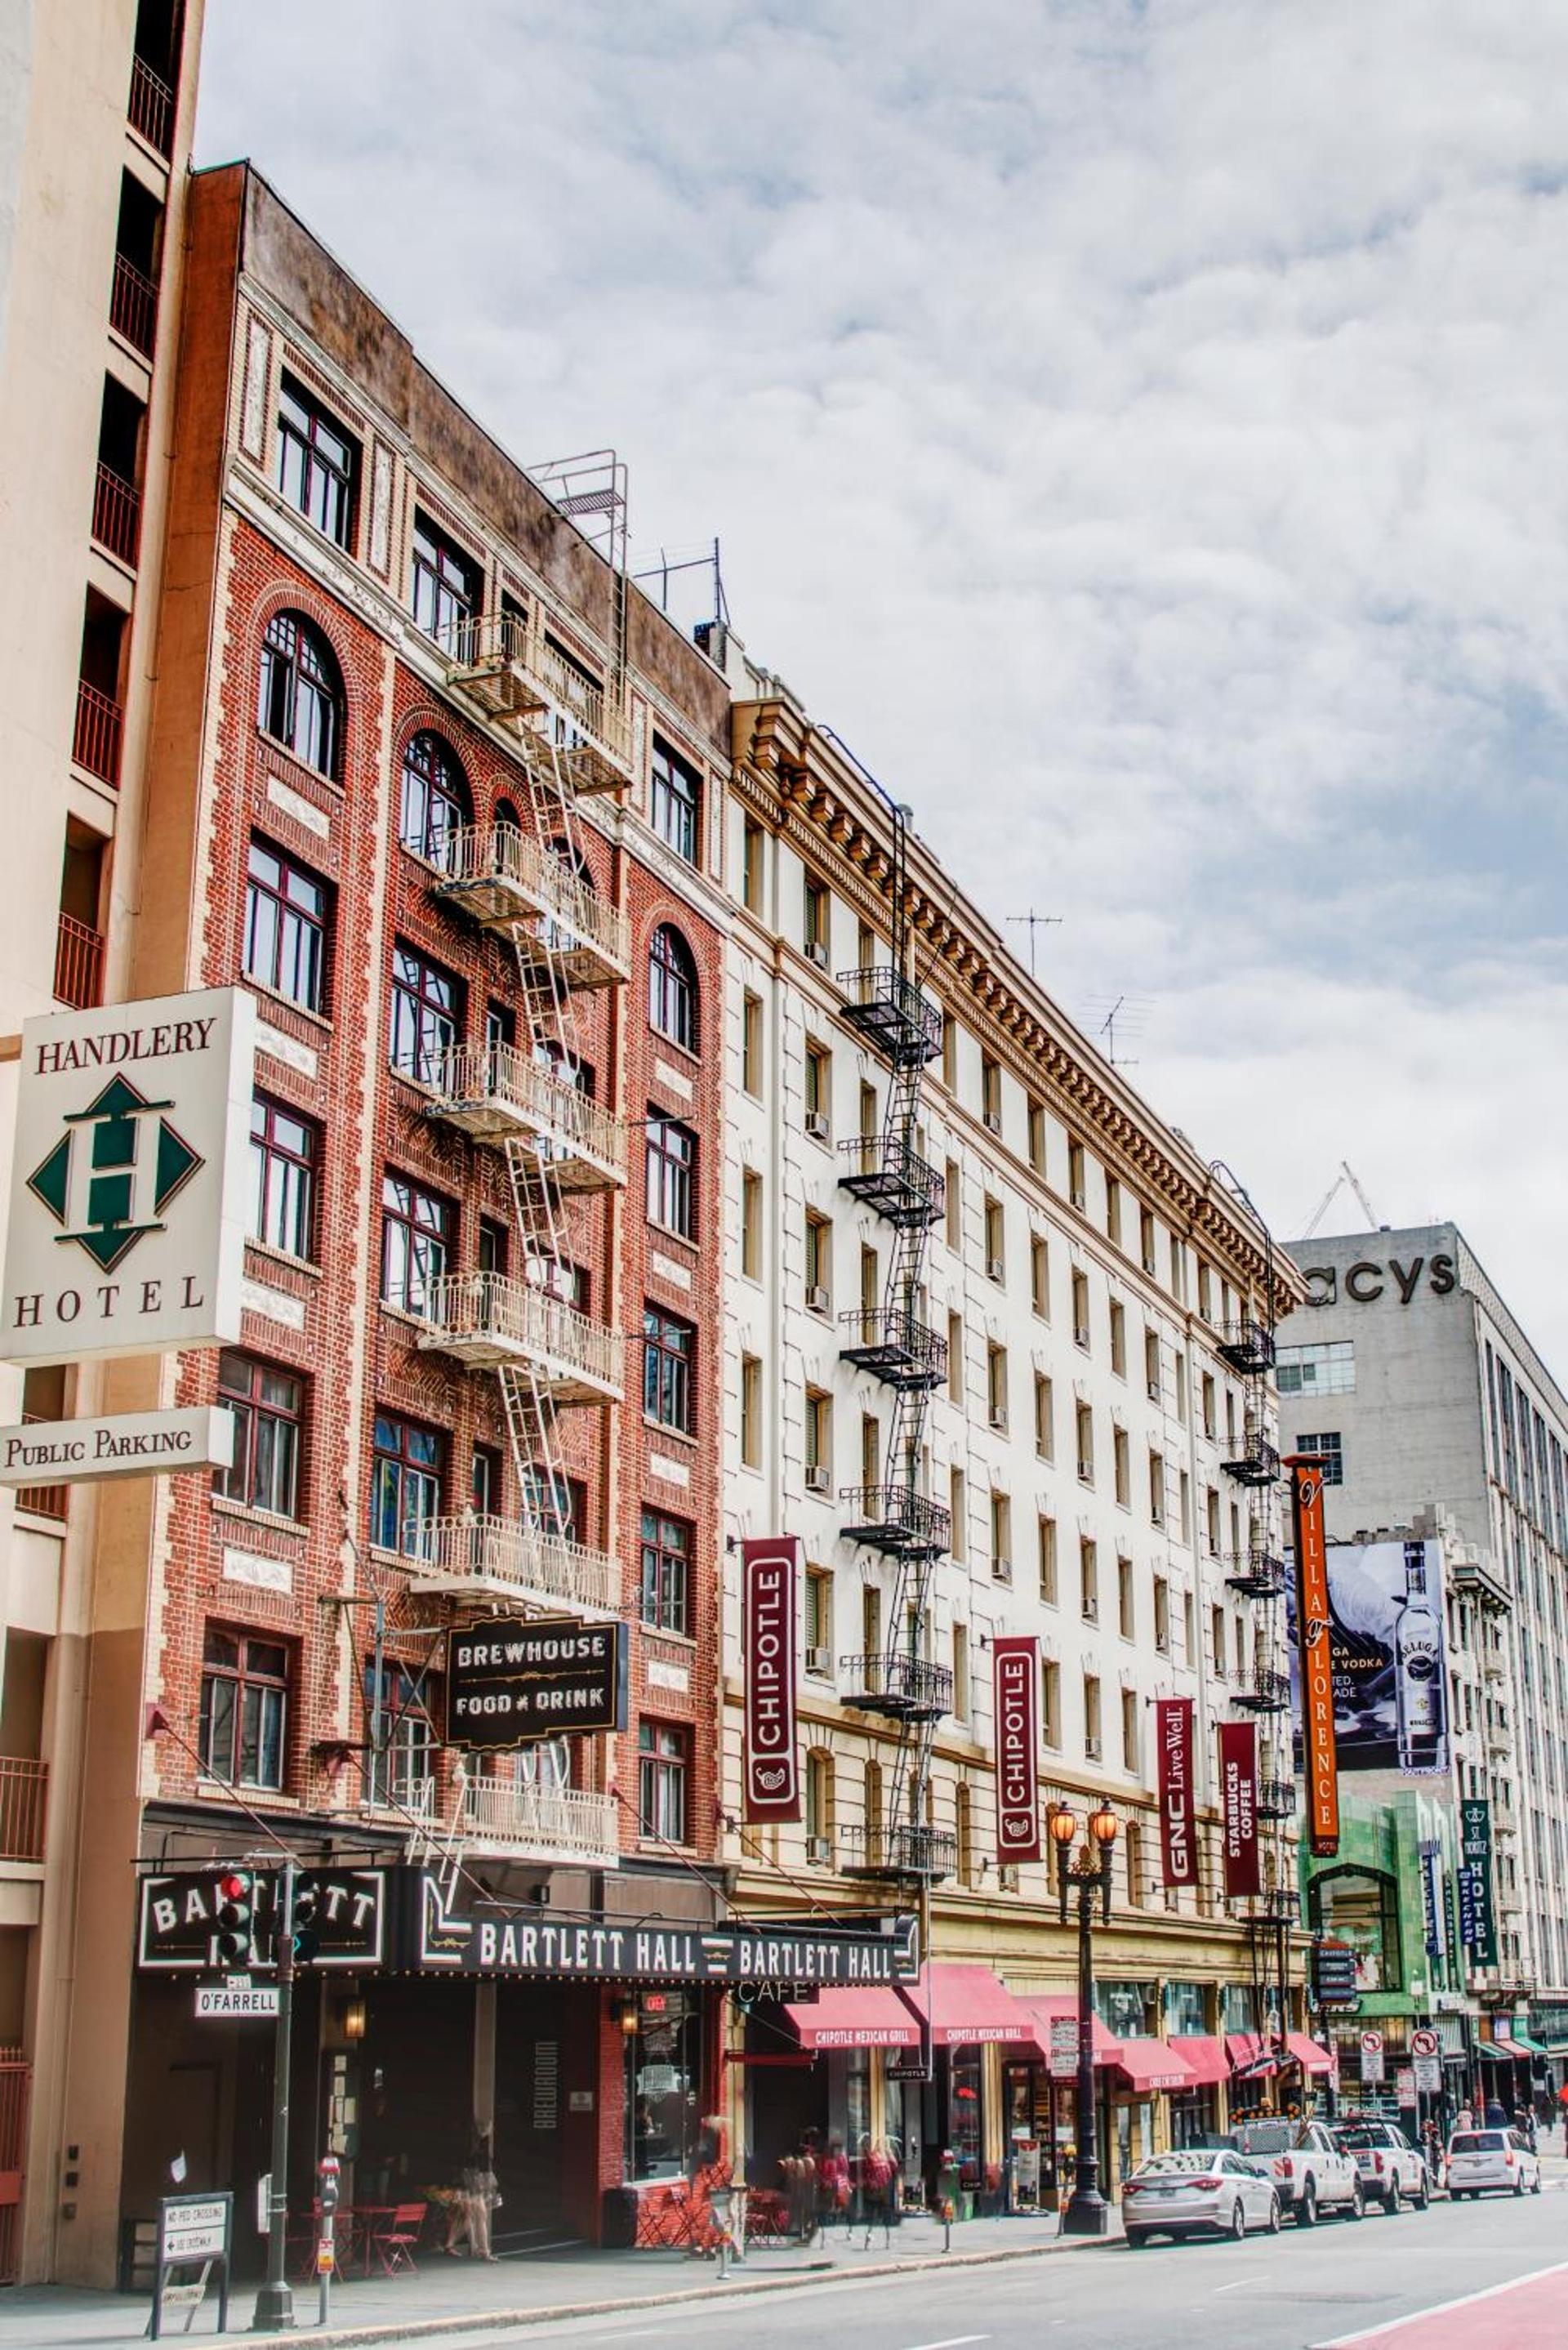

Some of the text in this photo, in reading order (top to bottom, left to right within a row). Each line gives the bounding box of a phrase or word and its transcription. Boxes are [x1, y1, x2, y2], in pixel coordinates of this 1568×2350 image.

[34, 1018, 216, 1075] HANDLERY
[13, 1275, 204, 1328] HOTEL
[1302, 1254, 1455, 1307] acys
[1299, 1477, 1329, 1612] VILLA
[457, 1636, 606, 1668] BREWHOUSE
[757, 1570, 781, 1746] CHIPOTLE
[1342, 1658, 1383, 1670] VODKA
[457, 1688, 605, 1716] FOOD DRINK
[1305, 1617, 1334, 1826] FLORENCE
[1005, 1662, 1026, 1803] CHIPOTLE
[1168, 1750, 1183, 1790] Live
[1168, 1793, 1189, 1879] GNC
[1227, 1762, 1241, 1858] STARBUCKS
[1240, 1779, 1252, 1839] COFFEE
[153, 1879, 376, 1933] BATTT
[1471, 1862, 1488, 1958] HOTEL
[480, 1924, 891, 1979] BARTLETT HALL BARTLETT HALL
[202, 1993, 275, 2010] O'FARRELL
[737, 1982, 808, 2004] CAFE
[816, 2030, 909, 2044] CHIPOTLE MEXICAN GRILL
[947, 2027, 1022, 2041] CHIPOTLE MEXICAN GRILL
